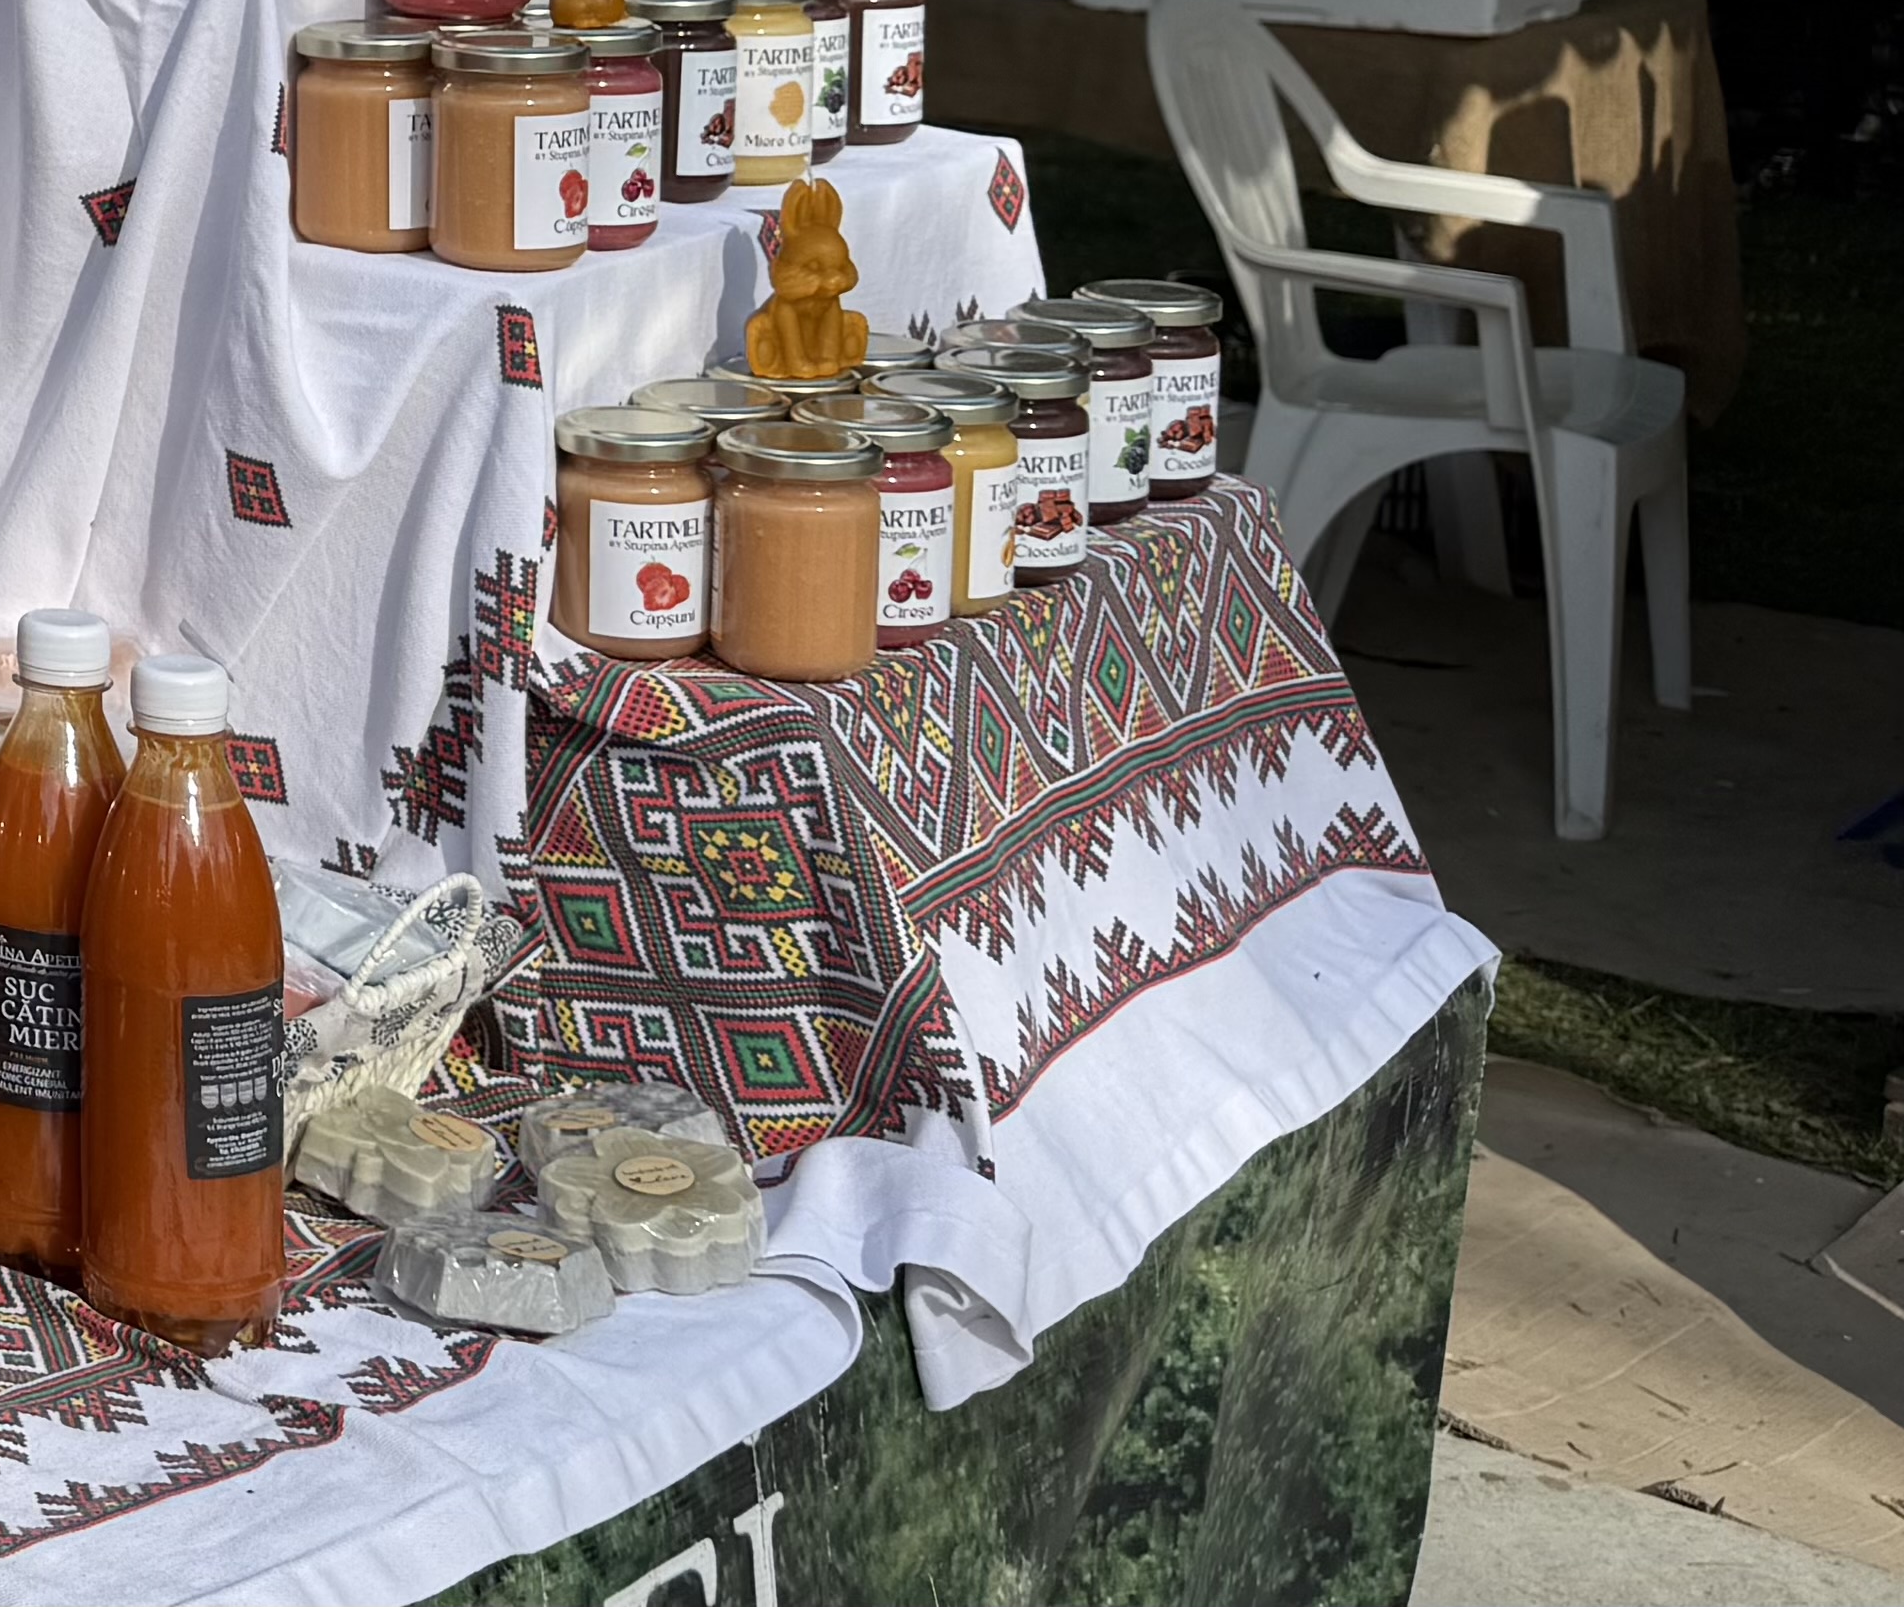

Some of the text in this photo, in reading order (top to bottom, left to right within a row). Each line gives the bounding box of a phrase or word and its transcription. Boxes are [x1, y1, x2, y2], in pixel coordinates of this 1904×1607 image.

[4, 977, 55, 1002] SUC
[1, 999, 81, 1027] CĂTIN
[9, 1024, 80, 1050] MIER
